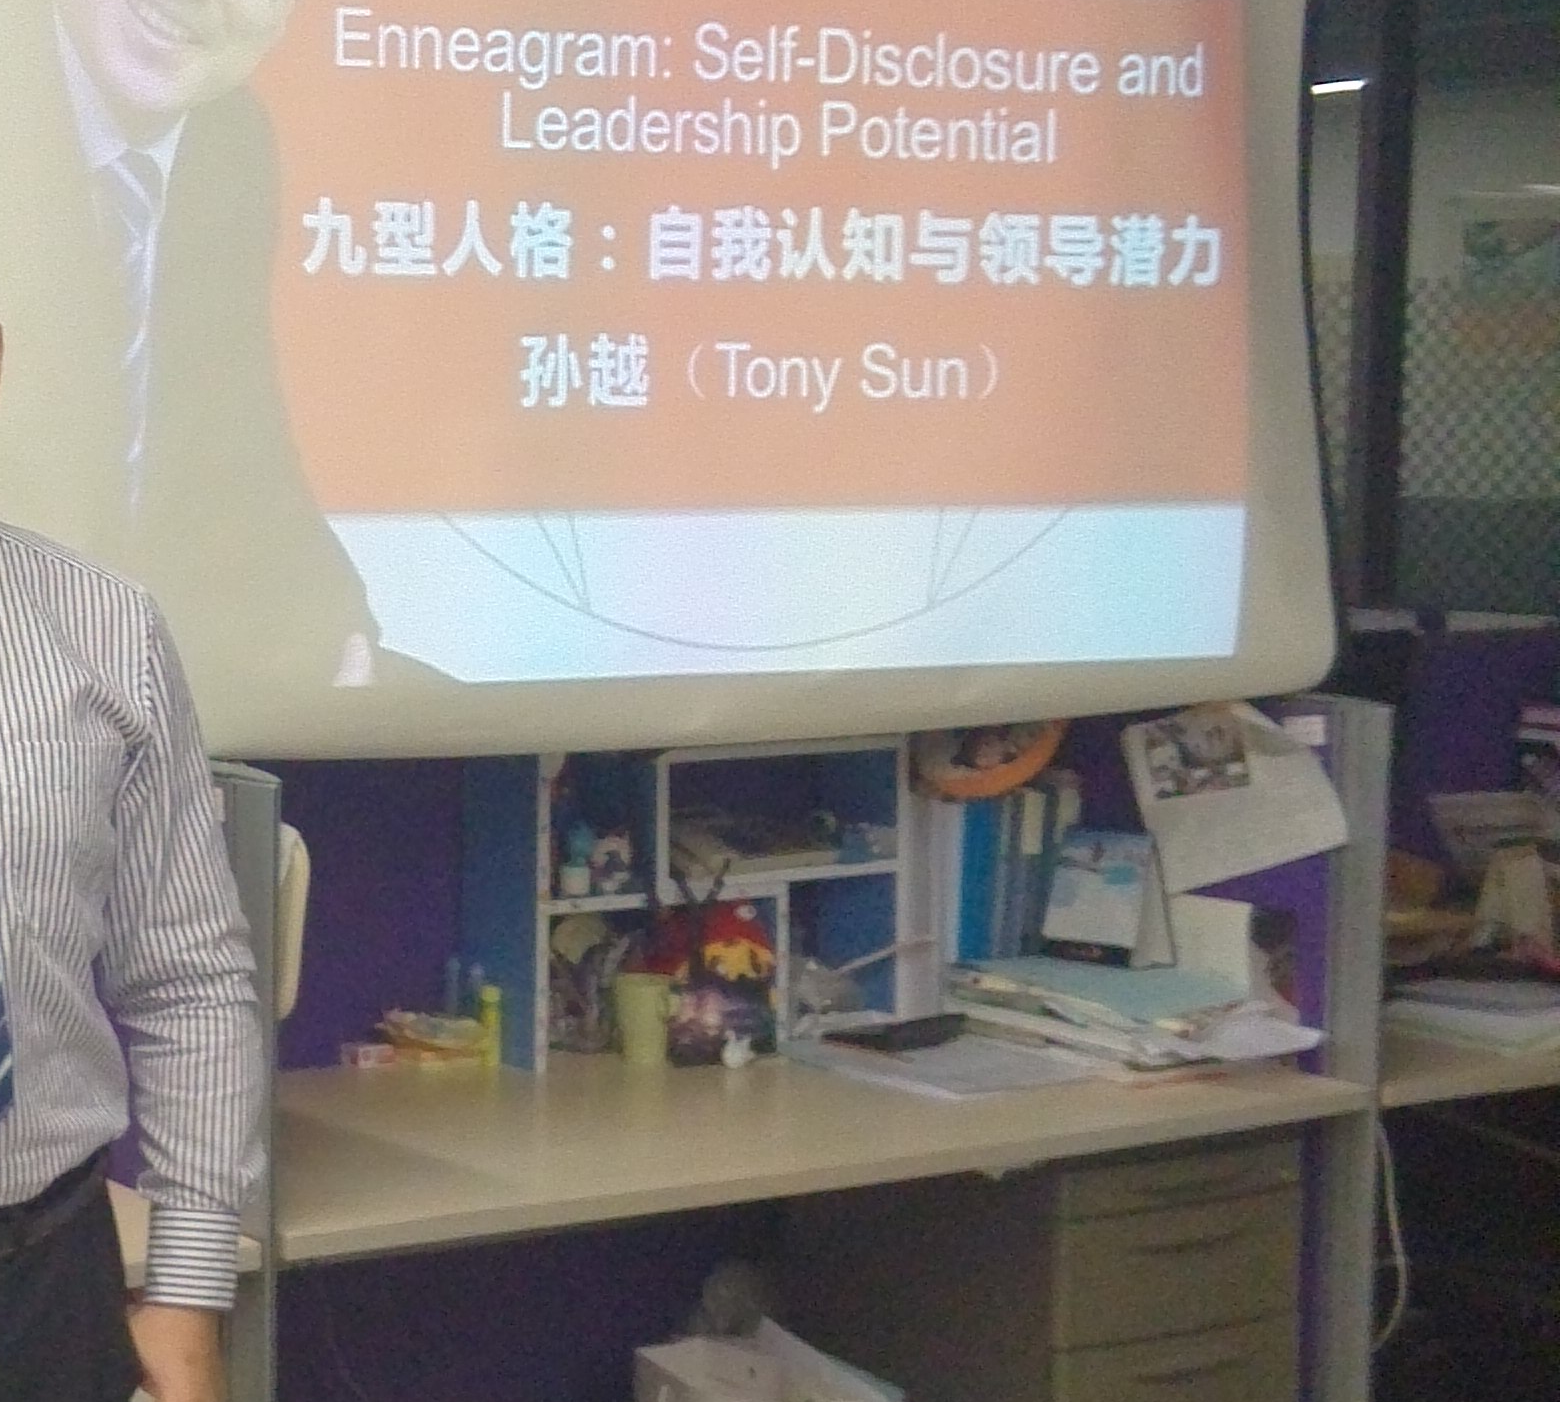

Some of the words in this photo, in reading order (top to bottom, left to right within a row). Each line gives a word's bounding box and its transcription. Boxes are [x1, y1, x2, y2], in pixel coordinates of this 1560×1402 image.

[333, 6, 674, 90] Enneagram:
[692, 21, 1102, 94] Self-Disclosure
[1116, 42, 1205, 97] and
[501, 91, 802, 171] Leadership
[820, 99, 1058, 164] Potential
[301, 196, 1223, 287] 九型人格：自我认知与领导潜力
